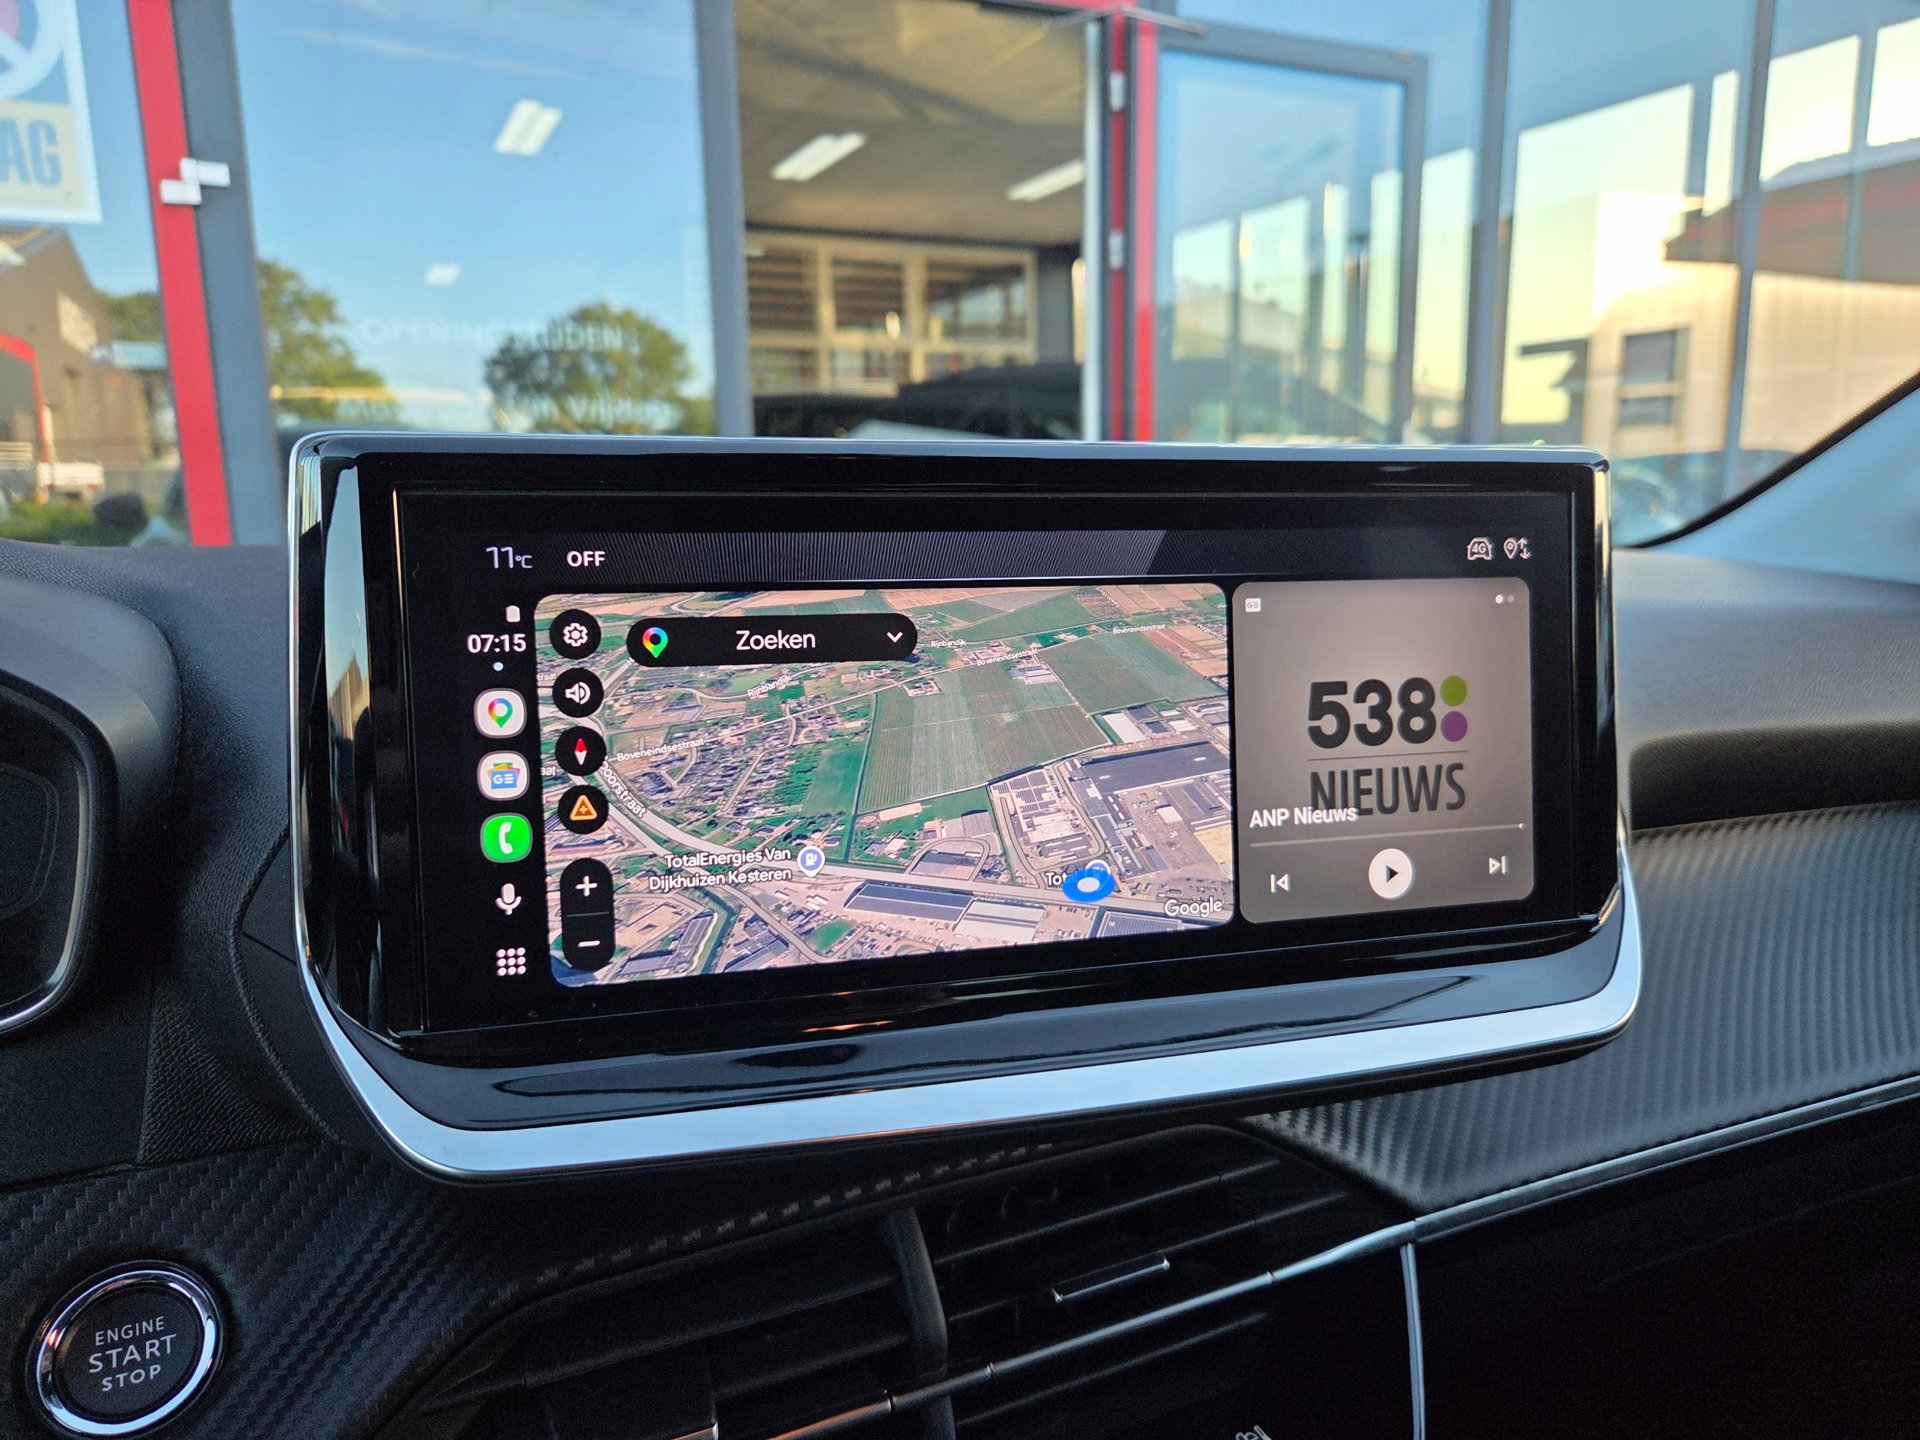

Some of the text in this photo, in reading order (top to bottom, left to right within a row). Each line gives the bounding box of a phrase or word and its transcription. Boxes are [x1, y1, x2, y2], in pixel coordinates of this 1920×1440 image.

[566, 550, 606, 568] OFF
[1472, 543, 1487, 554] 4G
[467, 633, 527, 654] 07:15
[735, 629, 816, 651] Zoeken
[747, 674, 793, 698] Rijnbandijk
[1308, 677, 1437, 749] 538
[616, 737, 705, 762] Boveneindsestraat
[1309, 762, 1466, 816] NIEUWS
[1250, 805, 1358, 828] ANP Nieuws
[664, 848, 792, 869] TotalEnergies Van
[649, 868, 792, 892] Dijkhuizen Kesteren
[1164, 898, 1224, 918] Google
[95, 1316, 165, 1346] ENGINE
[88, 1333, 177, 1373] START
[101, 1364, 161, 1392] STOP
